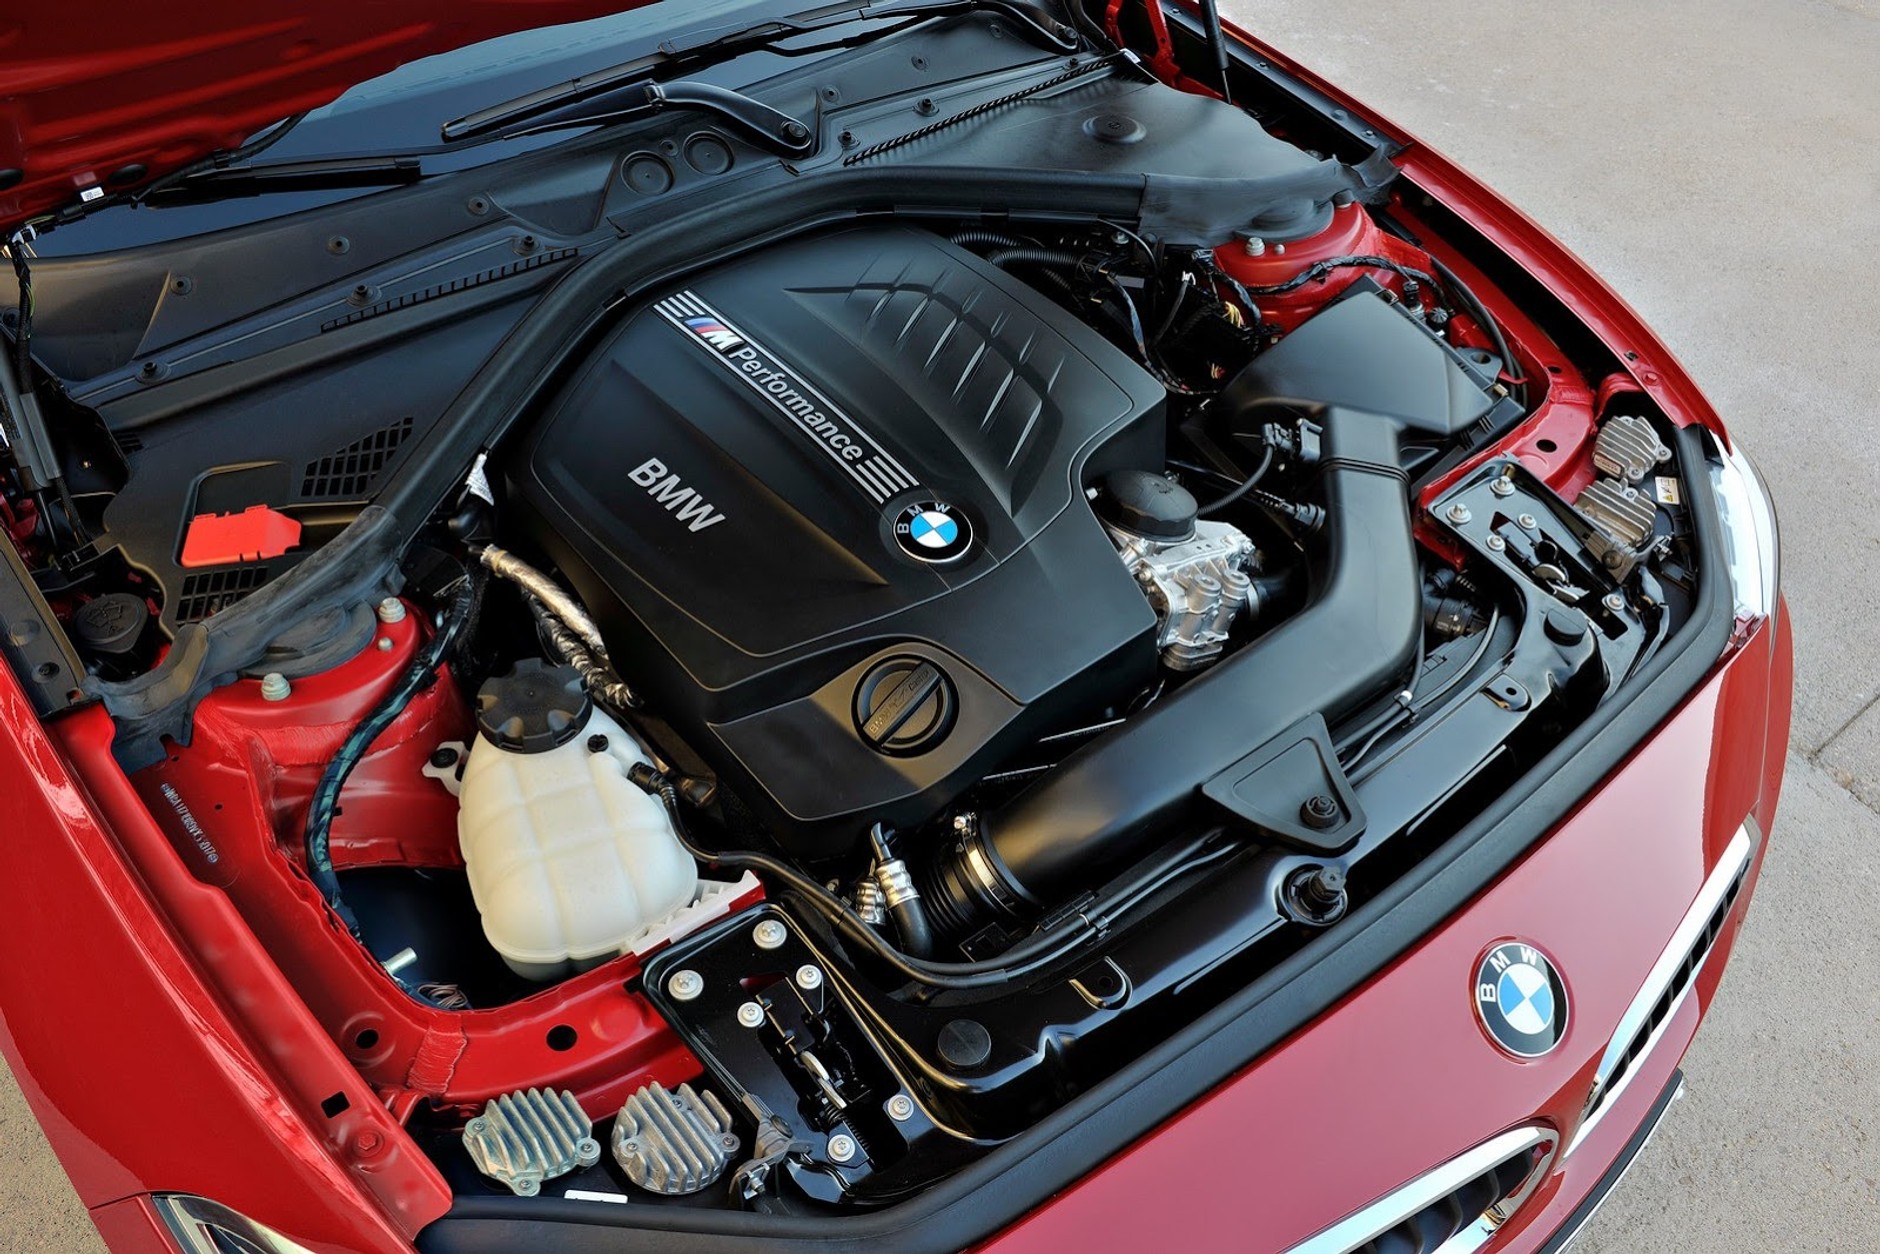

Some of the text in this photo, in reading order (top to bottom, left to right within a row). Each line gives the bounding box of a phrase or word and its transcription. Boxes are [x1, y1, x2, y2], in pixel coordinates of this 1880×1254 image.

[729, 347, 863, 461] Performance
[627, 457, 727, 533] BMW
[897, 502, 951, 534] BMW
[1480, 946, 1537, 1002] BMW
